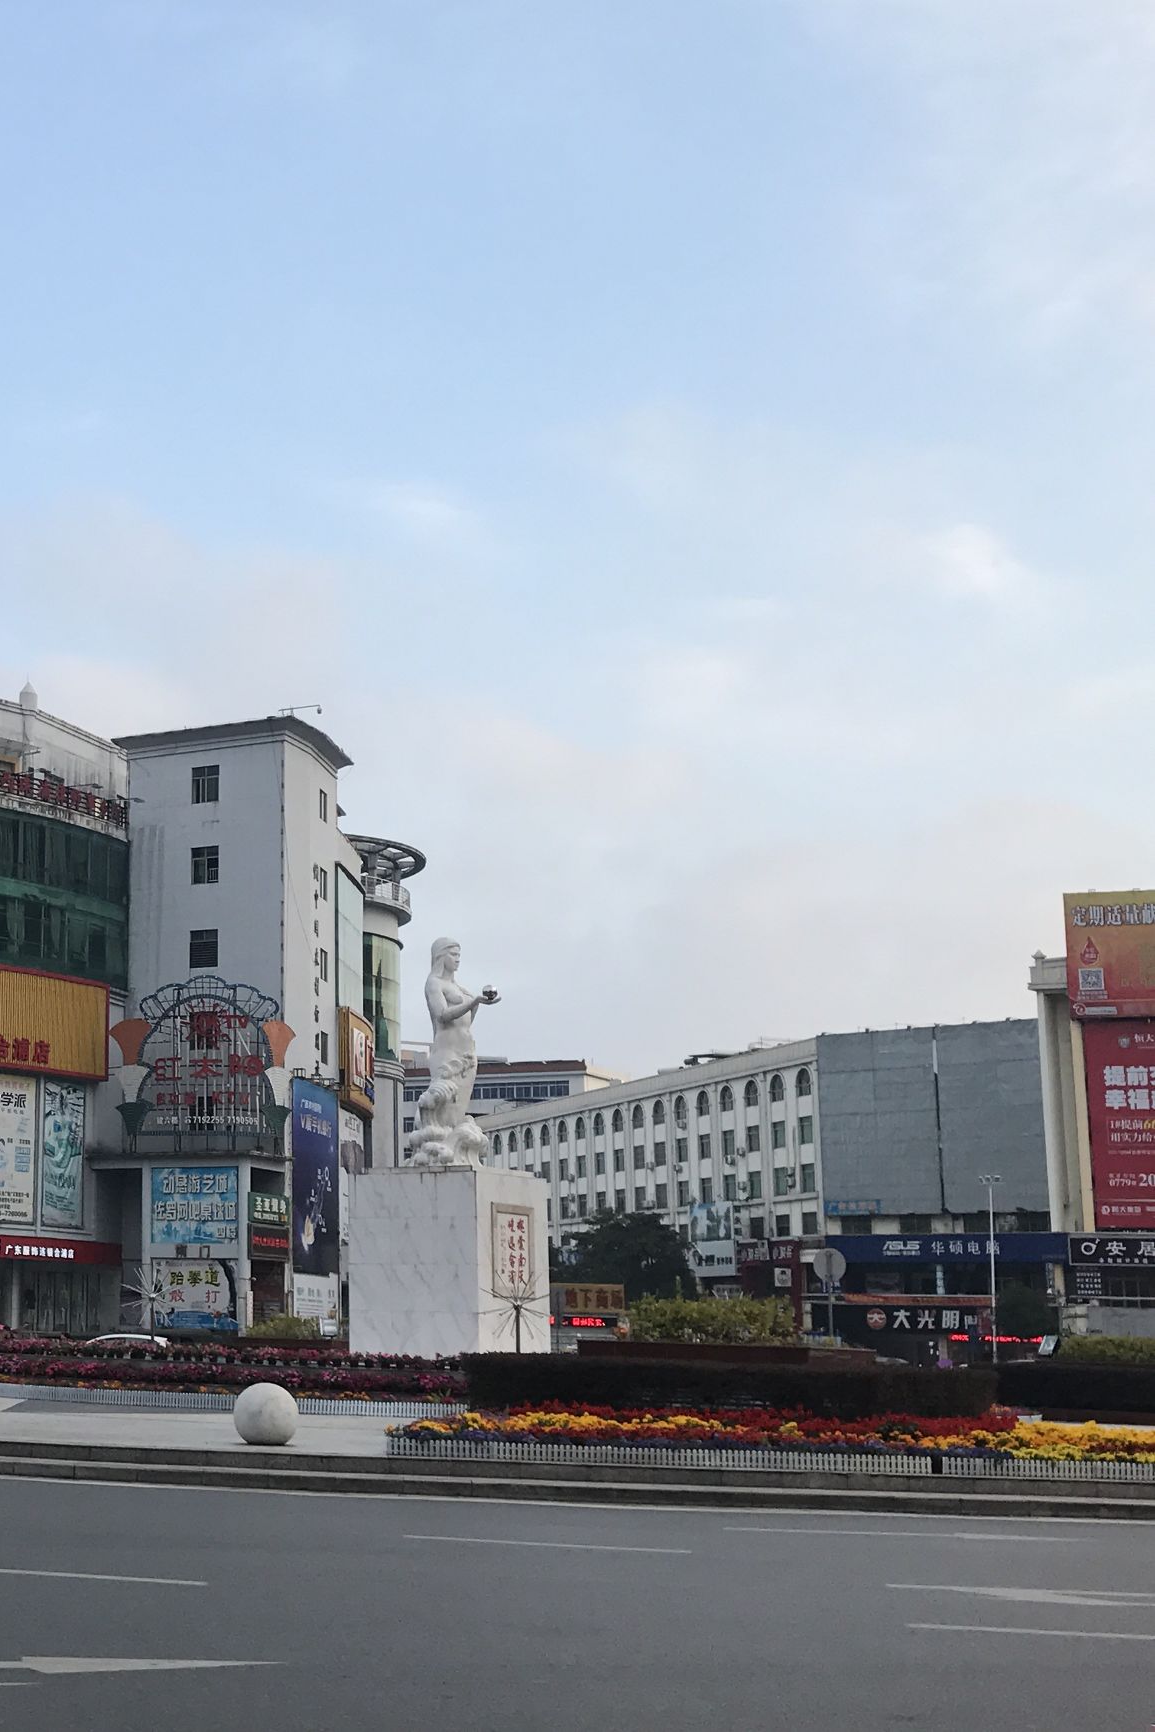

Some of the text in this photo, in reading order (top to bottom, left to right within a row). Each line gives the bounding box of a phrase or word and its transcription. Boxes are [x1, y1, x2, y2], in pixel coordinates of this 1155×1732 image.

[1105, 1089, 1155, 1110] 幸福
[882, 1240, 921, 1250] ASUS
[931, 1240, 1000, 1256] 华硕电脑
[169, 1269, 221, 1288] 跆拳道
